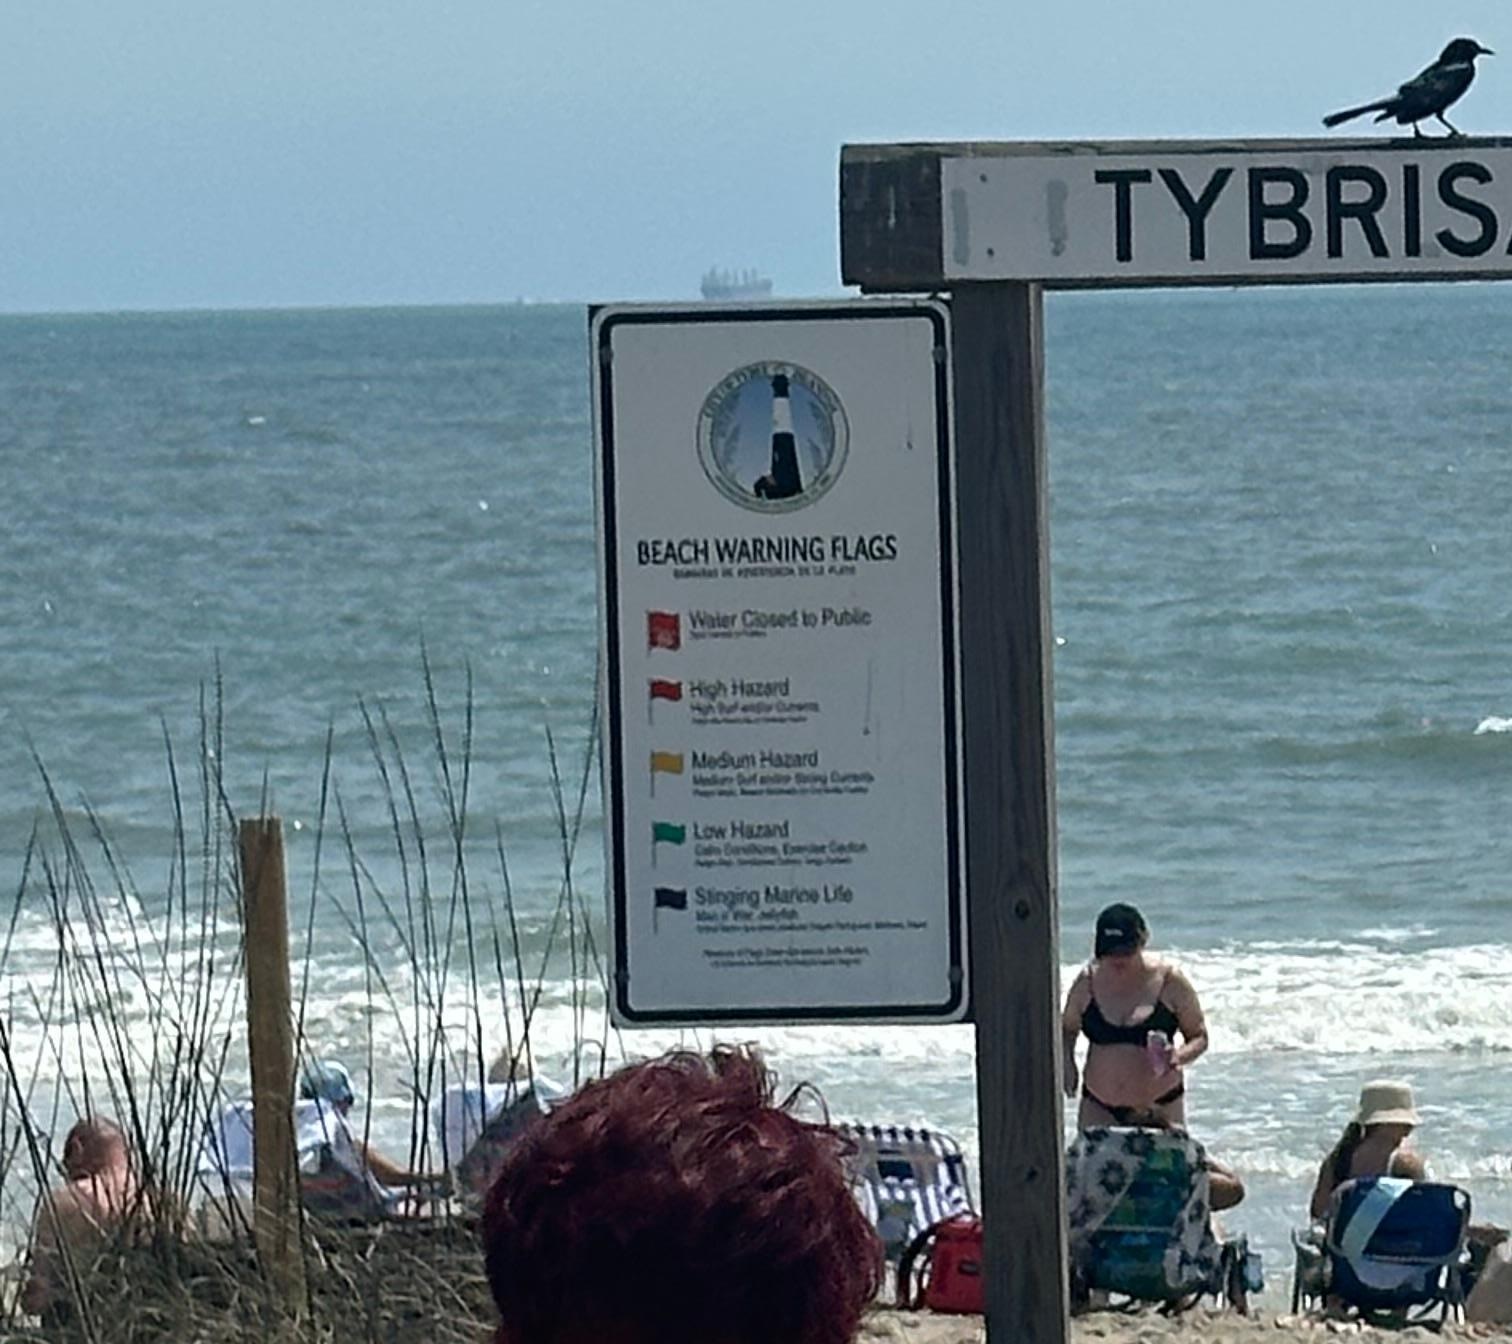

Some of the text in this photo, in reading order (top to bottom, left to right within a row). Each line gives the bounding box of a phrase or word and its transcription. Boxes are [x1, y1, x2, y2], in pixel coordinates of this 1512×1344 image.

[636, 532, 899, 566] BEACH WARNING FLAGS
[688, 607, 873, 630] Water Closed to Public
[689, 677, 791, 701] High Hazard
[691, 749, 820, 771] Medium Hazard
[693, 820, 790, 840] Low Hazard
[694, 884, 853, 908] Stinging Marine Life
